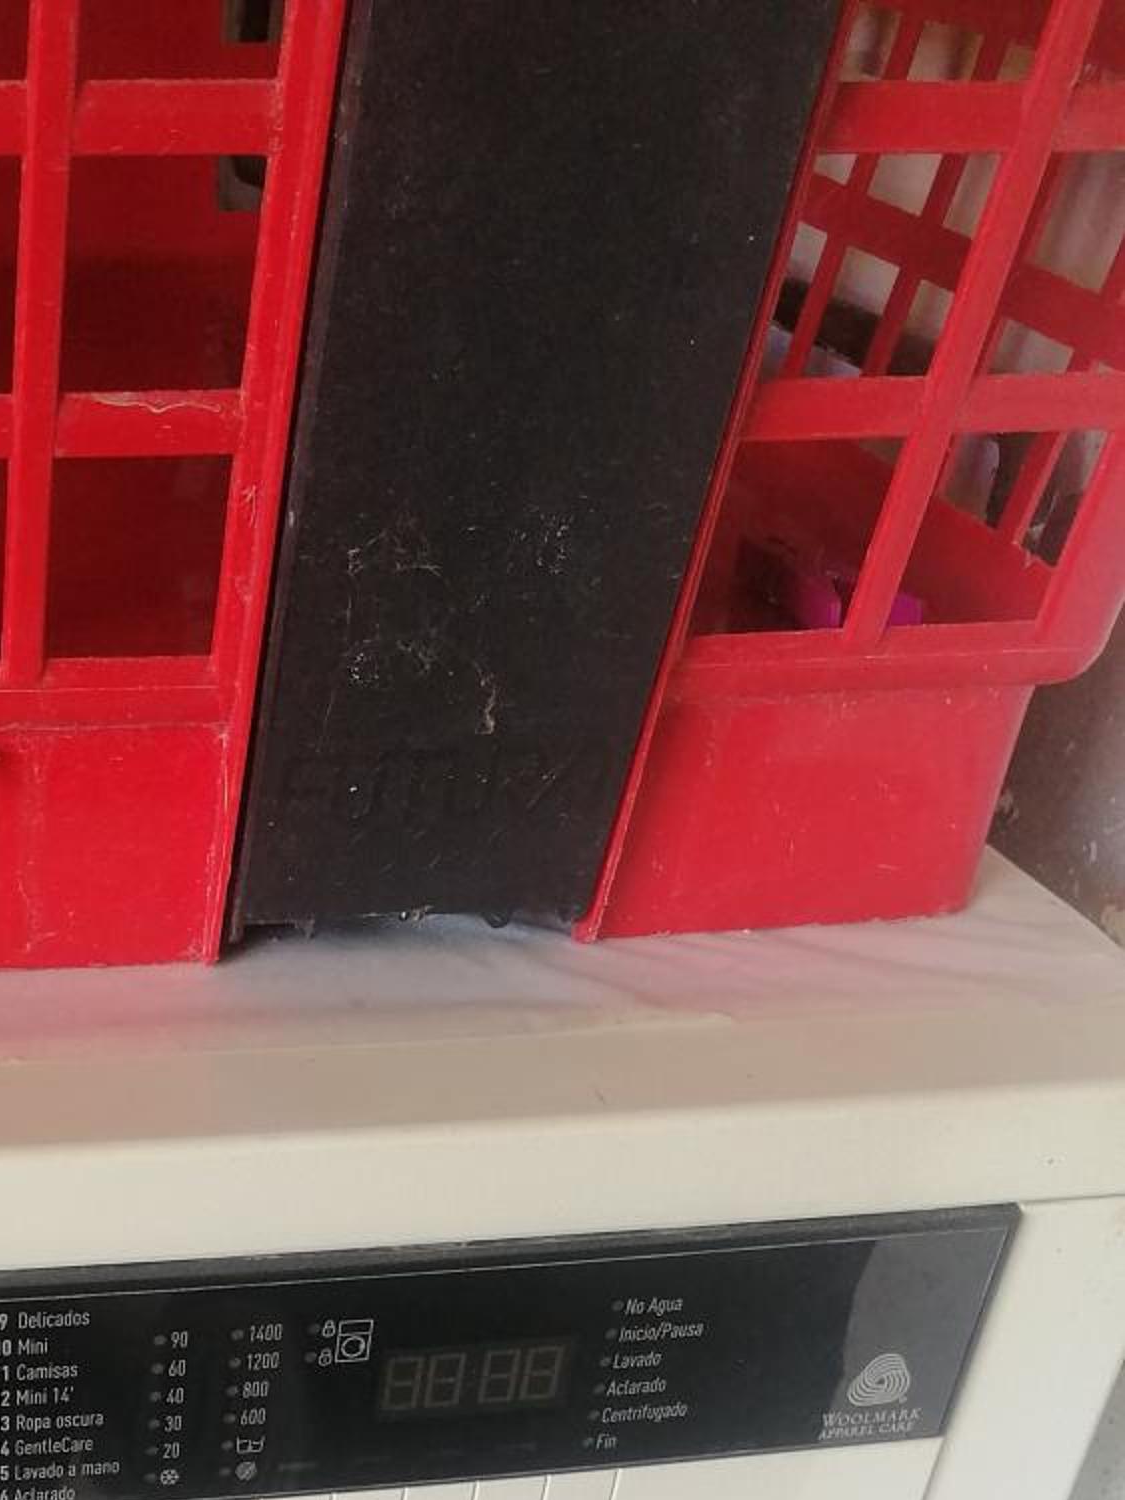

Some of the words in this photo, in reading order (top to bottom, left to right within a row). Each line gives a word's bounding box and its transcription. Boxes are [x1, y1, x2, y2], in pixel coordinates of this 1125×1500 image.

[625, 1298, 644, 1315] No
[647, 1298, 683, 1317] Agua
[18, 1309, 90, 1329] Delicados
[171, 1331, 188, 1349] 90
[250, 1323, 283, 1342] 1400
[18, 1337, 48, 1356] Mini
[168, 1359, 186, 1377] 60
[247, 1351, 280, 1371] 1200
[613, 1351, 662, 1369] Lavado
[16, 1363, 78, 1381] Camisas
[166, 1387, 184, 1404] 40
[242, 1380, 270, 1399] 800
[606, 1377, 667, 1397] Aclarado
[16, 1388, 48, 1406] Mini
[240, 1408, 266, 1425] 600
[602, 1401, 689, 1423] Centrifugado
[823, 1407, 922, 1427] WOOLMARK
[16, 1414, 51, 1433] Ropa
[56, 1413, 104, 1430] oscura
[164, 1415, 182, 1432] 30
[14, 1437, 94, 1456] GentleCare
[162, 1442, 180, 1459] 20
[596, 1433, 618, 1450] Fin
[14, 1463, 64, 1481] Lavado
[68, 1466, 76, 1478] a
[82, 1460, 120, 1476] mano
